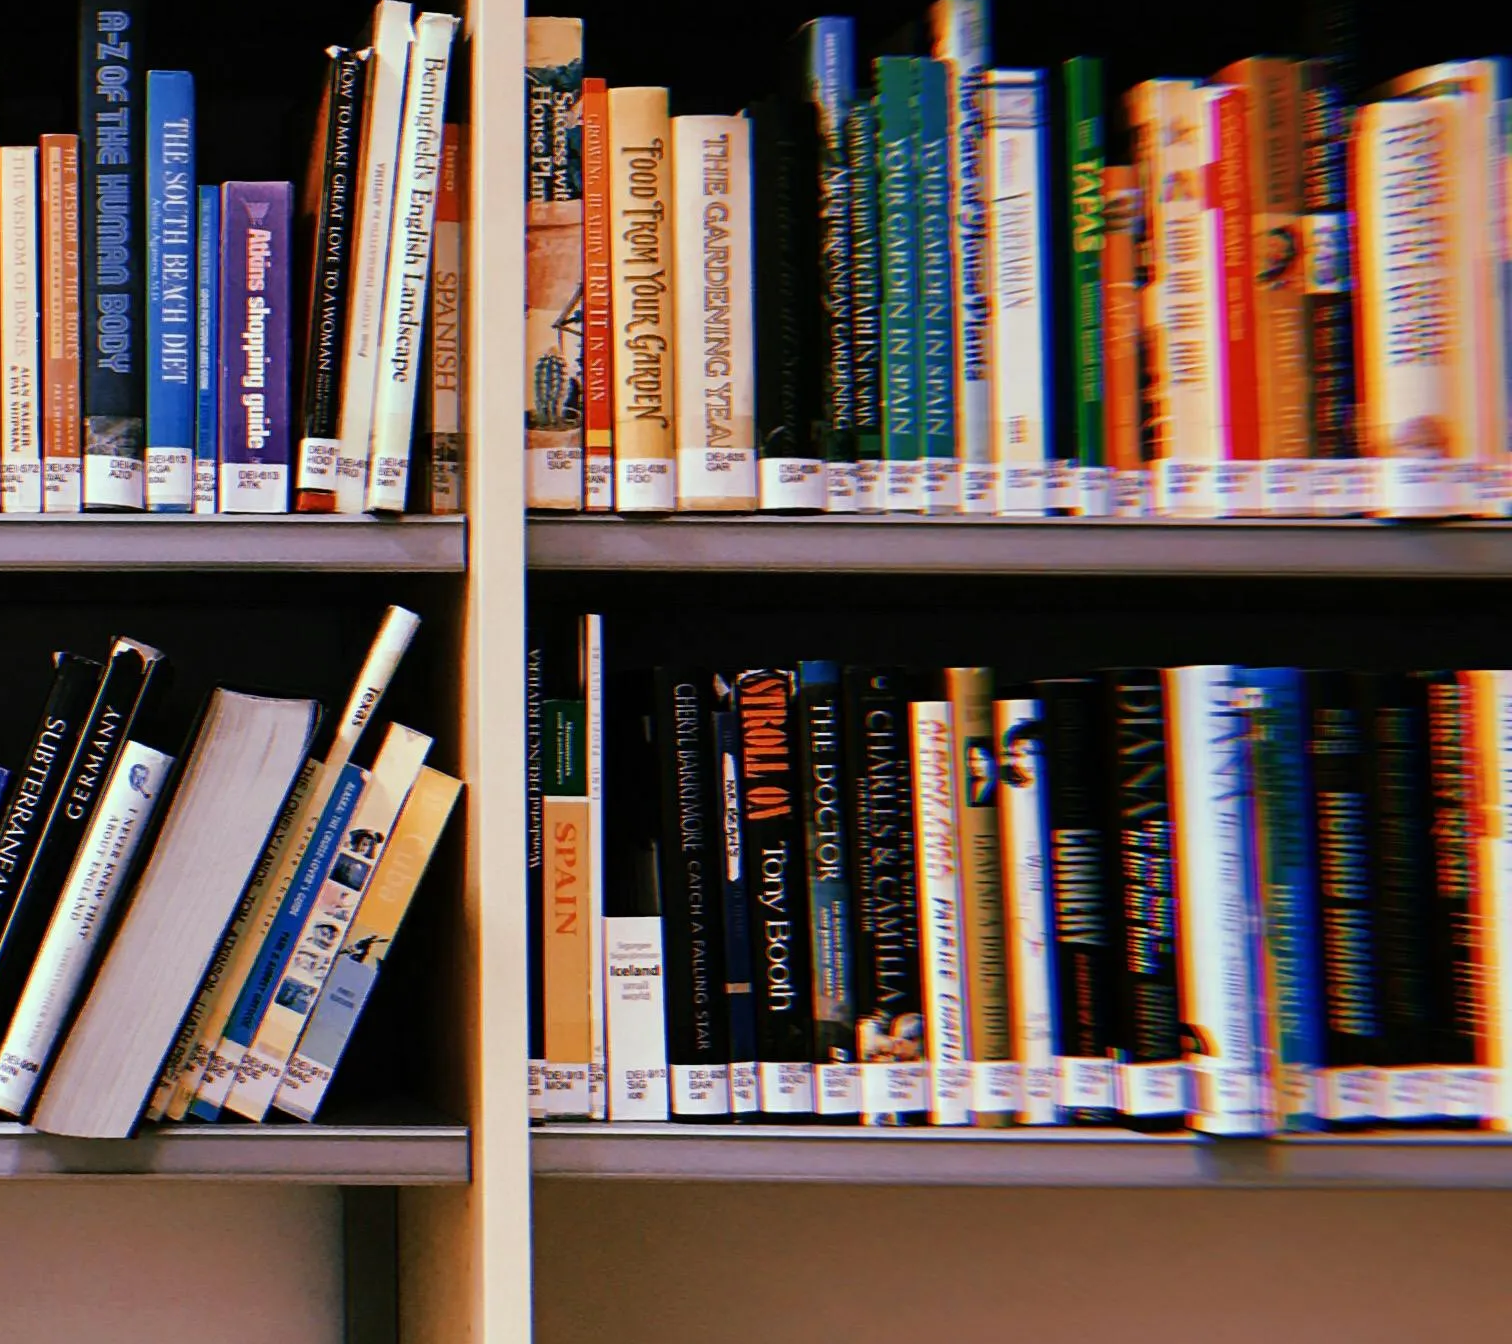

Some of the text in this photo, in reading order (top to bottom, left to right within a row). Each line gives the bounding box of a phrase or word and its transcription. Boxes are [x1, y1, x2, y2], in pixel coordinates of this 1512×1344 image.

[95, 10, 130, 373] A-Z OF THE HUMAN BODY
[530, 86, 549, 153] House
[553, 91, 573, 167] Success
[161, 118, 188, 384] THE SOUTH BEACH DIET
[391, 57, 446, 384] Beningfield's English Landscape
[887, 136, 918, 435] YOUR GARDEN IN SPAIN
[1071, 160, 1106, 253] TAPAS
[242, 228, 272, 449] Atkins shopping guide
[434, 270, 458, 393] SPANISH
[819, 167, 851, 431] MEDITERRANEAN GARDENING
[65, 704, 122, 821] GERMANY
[350, 684, 383, 728] Texas
[673, 683, 704, 852] CHERYL BARRYMORE
[739, 675, 792, 820] STROLL ON
[810, 699, 841, 883] THE DOCTOR
[866, 710, 904, 1003] CHARLES & CAMILLA
[553, 821, 578, 938] SPAIN
[757, 840, 795, 1012] Tony Booth
[609, 964, 661, 977] Iceland
